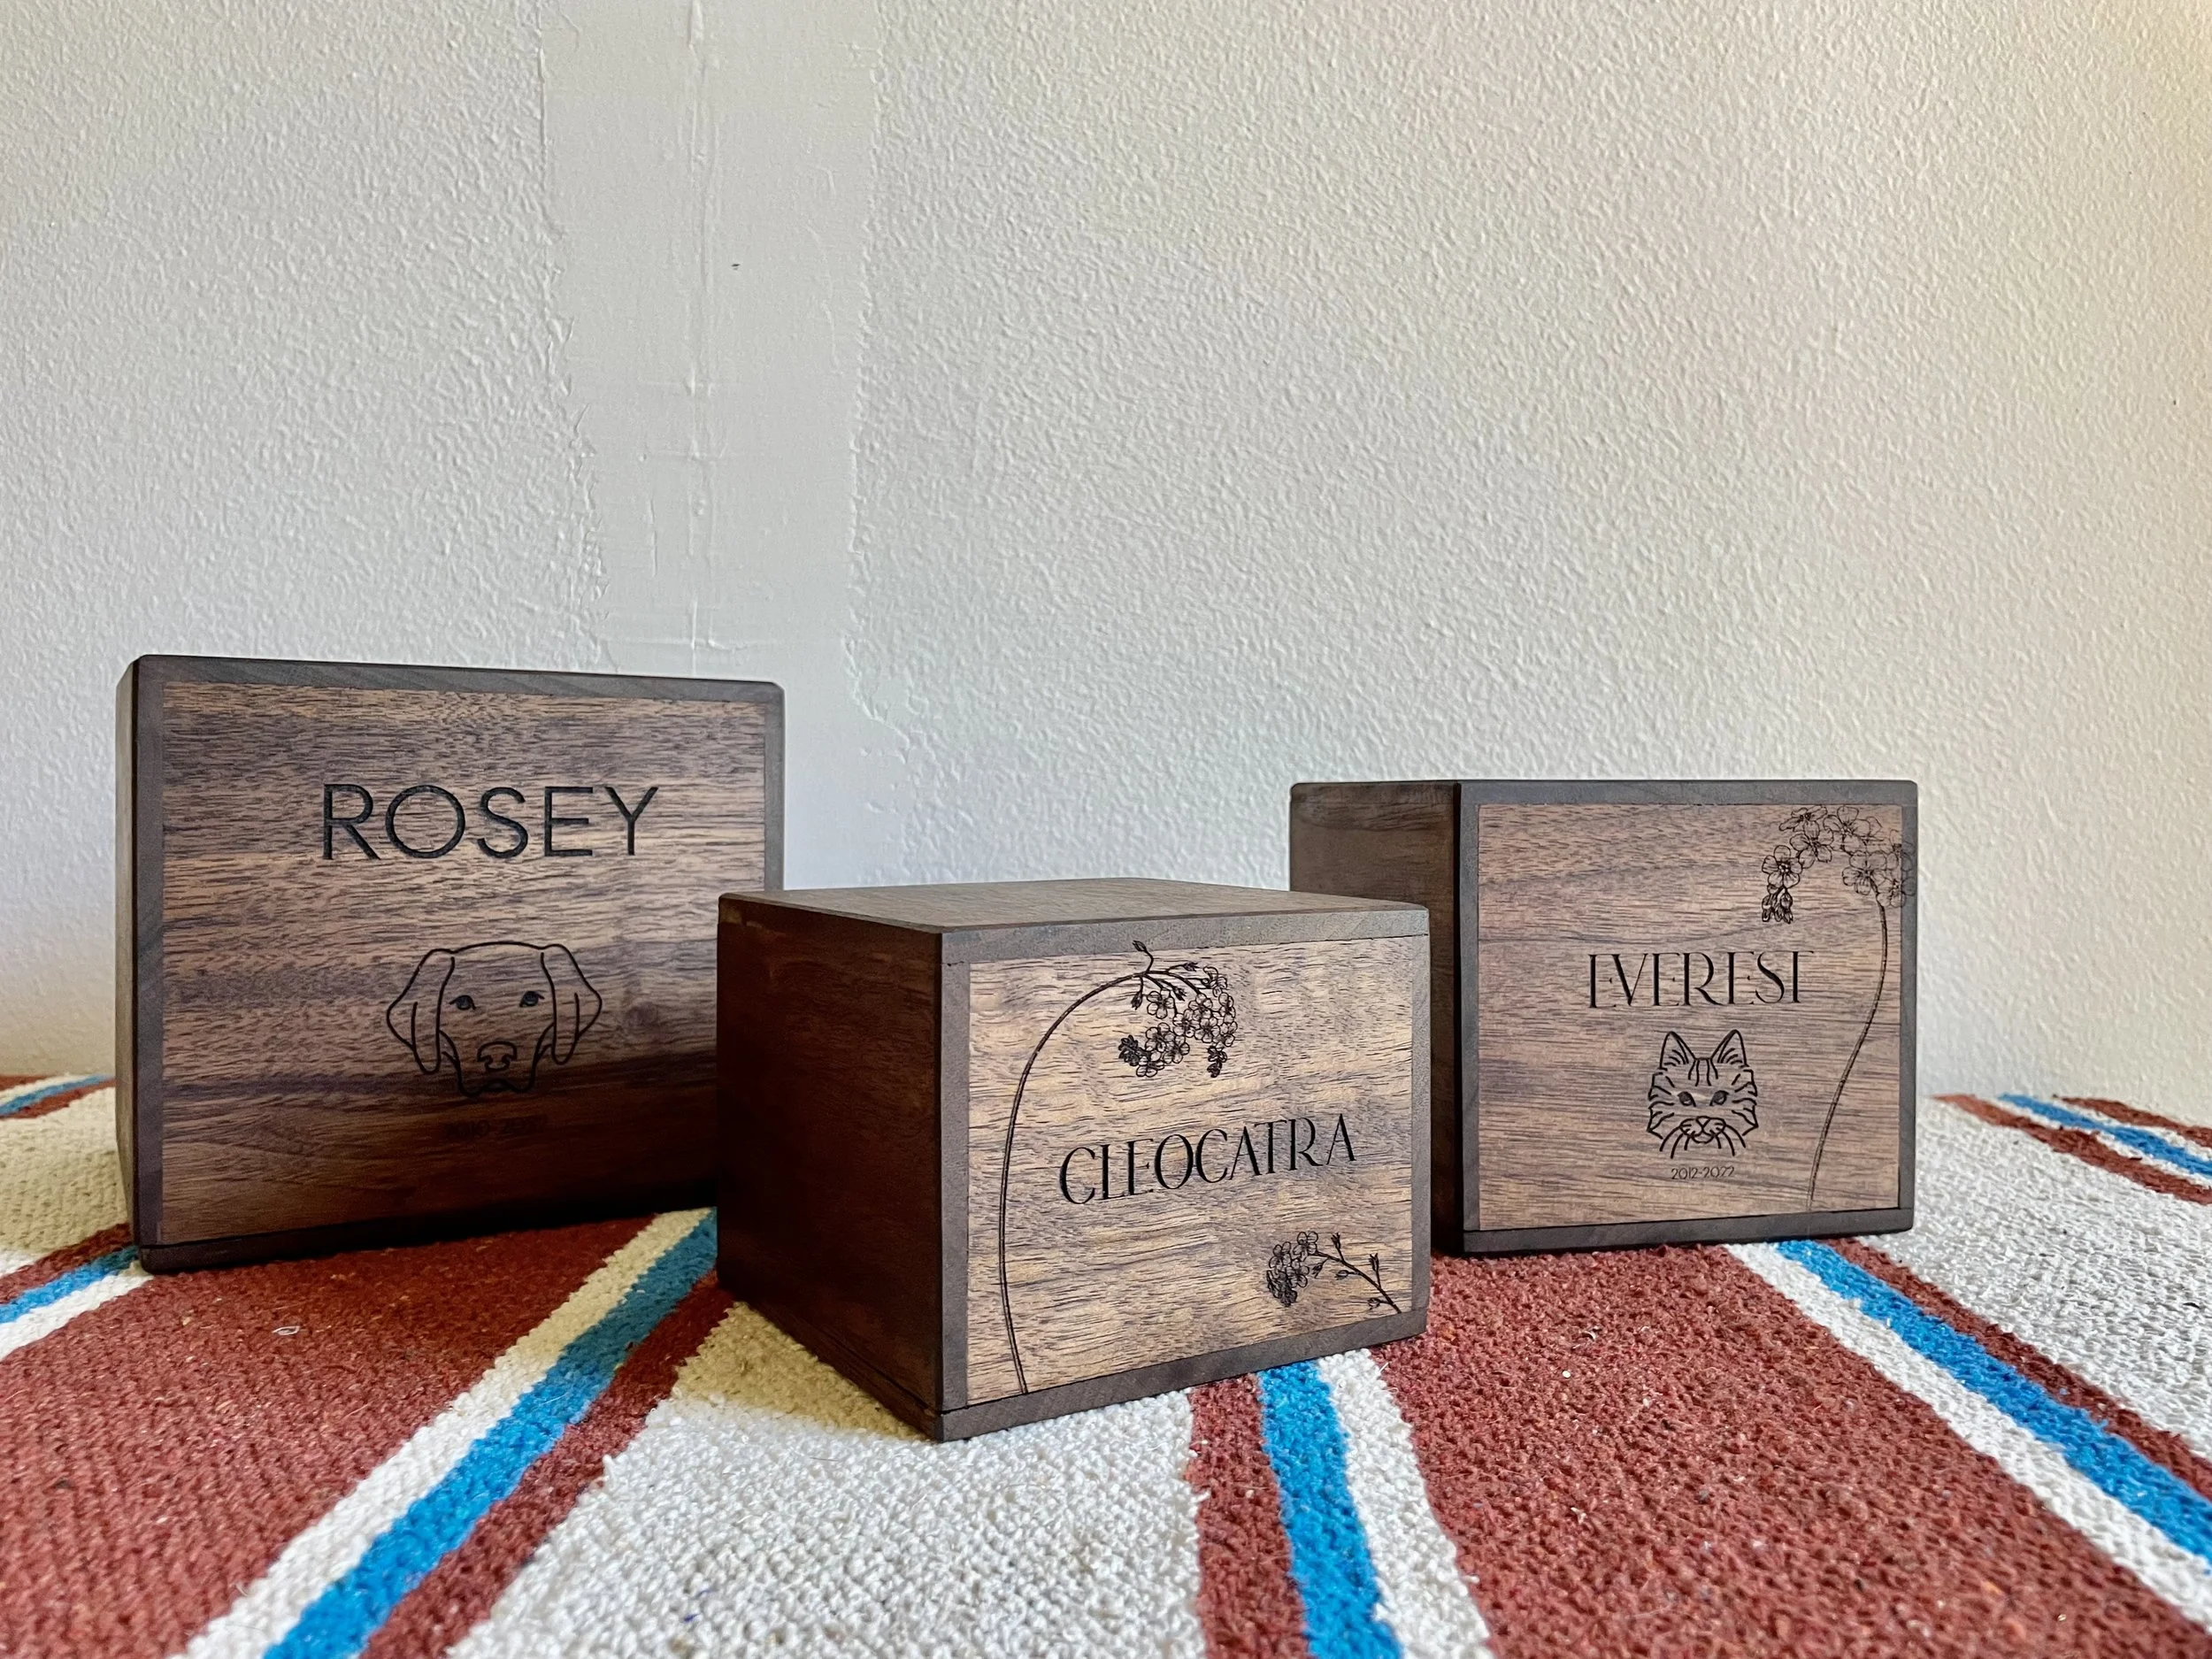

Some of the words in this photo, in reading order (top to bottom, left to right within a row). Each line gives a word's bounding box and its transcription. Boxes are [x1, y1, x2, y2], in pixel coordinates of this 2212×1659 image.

[322, 782, 659, 861] ROSEY
[1587, 949, 1815, 1009] EVEREST
[1059, 1113, 1357, 1205] CLEOCATRA
